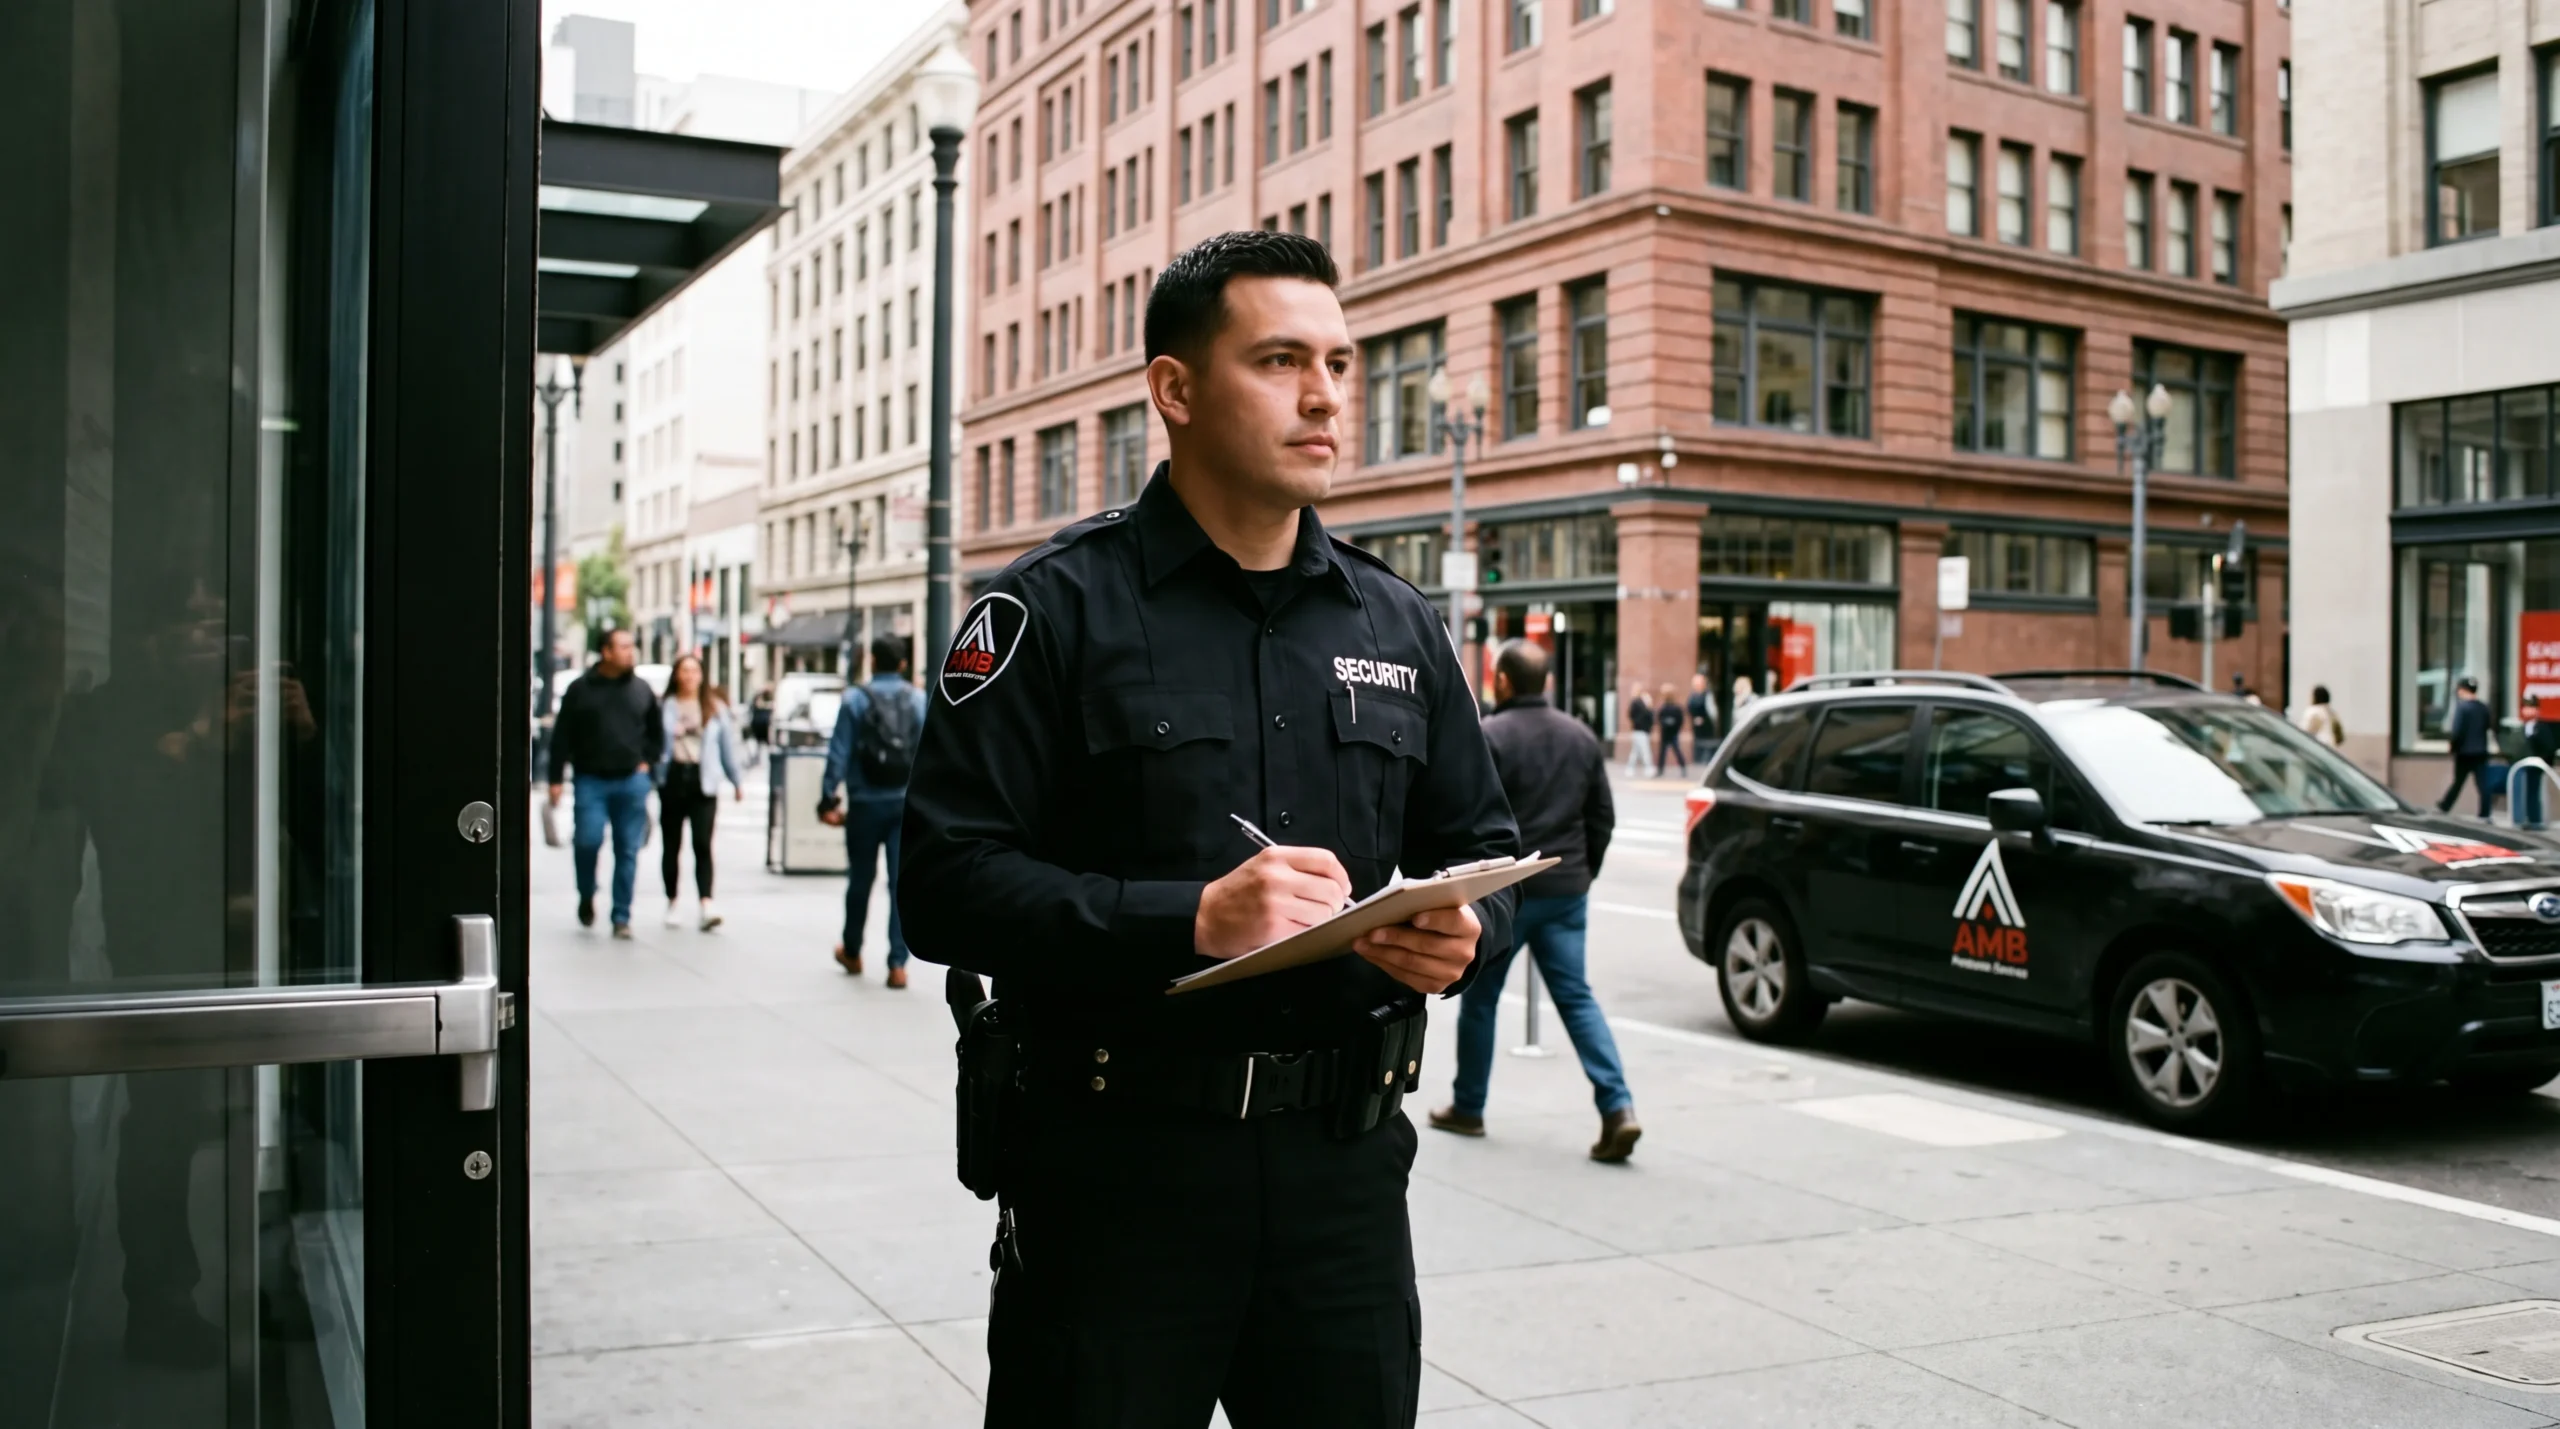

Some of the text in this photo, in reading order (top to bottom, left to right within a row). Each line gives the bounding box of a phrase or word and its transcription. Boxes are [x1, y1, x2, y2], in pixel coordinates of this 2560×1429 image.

[948, 650, 994, 673] AMB
[1333, 656, 1418, 694] SECURITY
[1952, 921, 2029, 965] AMB
